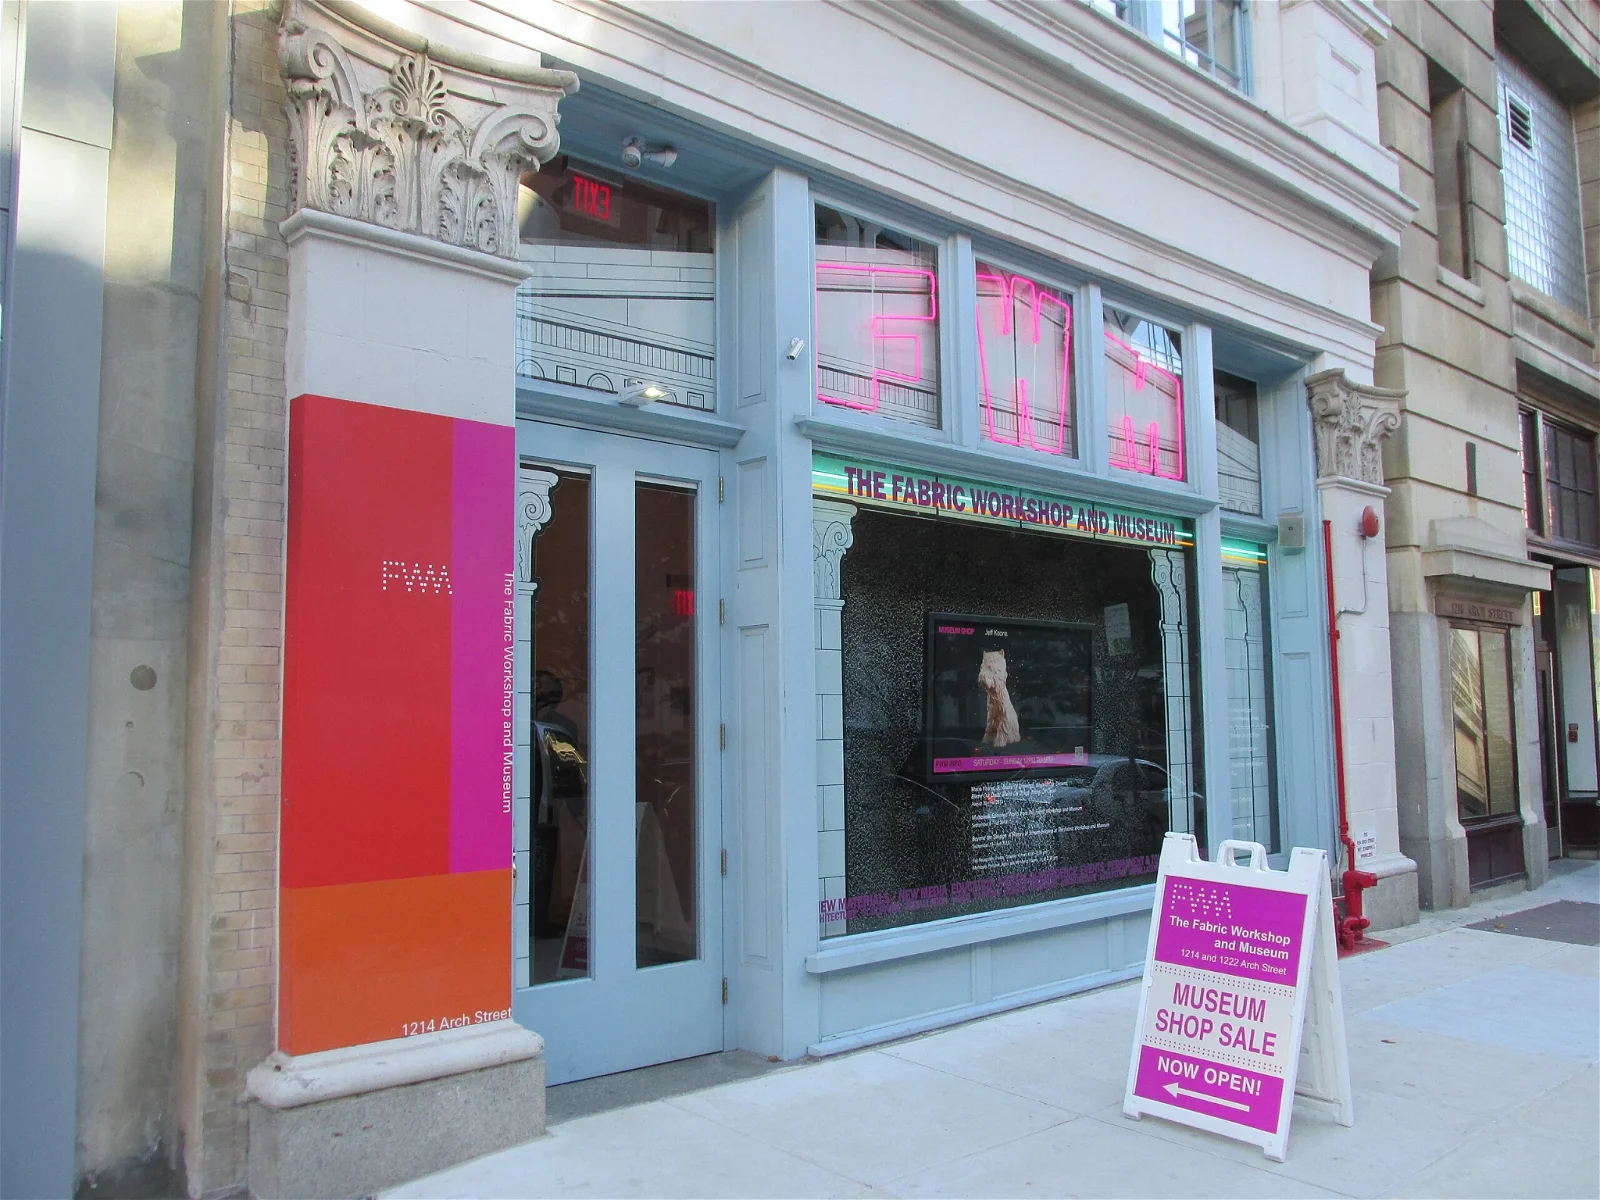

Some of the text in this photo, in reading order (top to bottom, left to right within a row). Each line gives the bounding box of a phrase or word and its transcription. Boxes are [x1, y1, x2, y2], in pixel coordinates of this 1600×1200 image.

[844, 466, 1176, 545] THE FABRIC WORKSHOP AND MUSEUM
[1488, 607, 1515, 621] STREET
[938, 626, 975, 635] MUSEUM SHOP
[994, 629, 1008, 637] Koons
[501, 571, 515, 814] The Fabric Workshop and Museum
[974, 758, 999, 767] SATURDAY
[1170, 915, 1291, 947] The Fabric Workshop
[1181, 948, 1287, 975] 1214 and 1222 Arch Street
[1214, 939, 1289, 960] and Museum
[1172, 982, 1266, 1023] MUSEUM
[402, 1007, 513, 1036] 1214 Arch Street
[1155, 1008, 1277, 1057] SHOP SALE
[1157, 1056, 1262, 1096] NOW OPEN!
